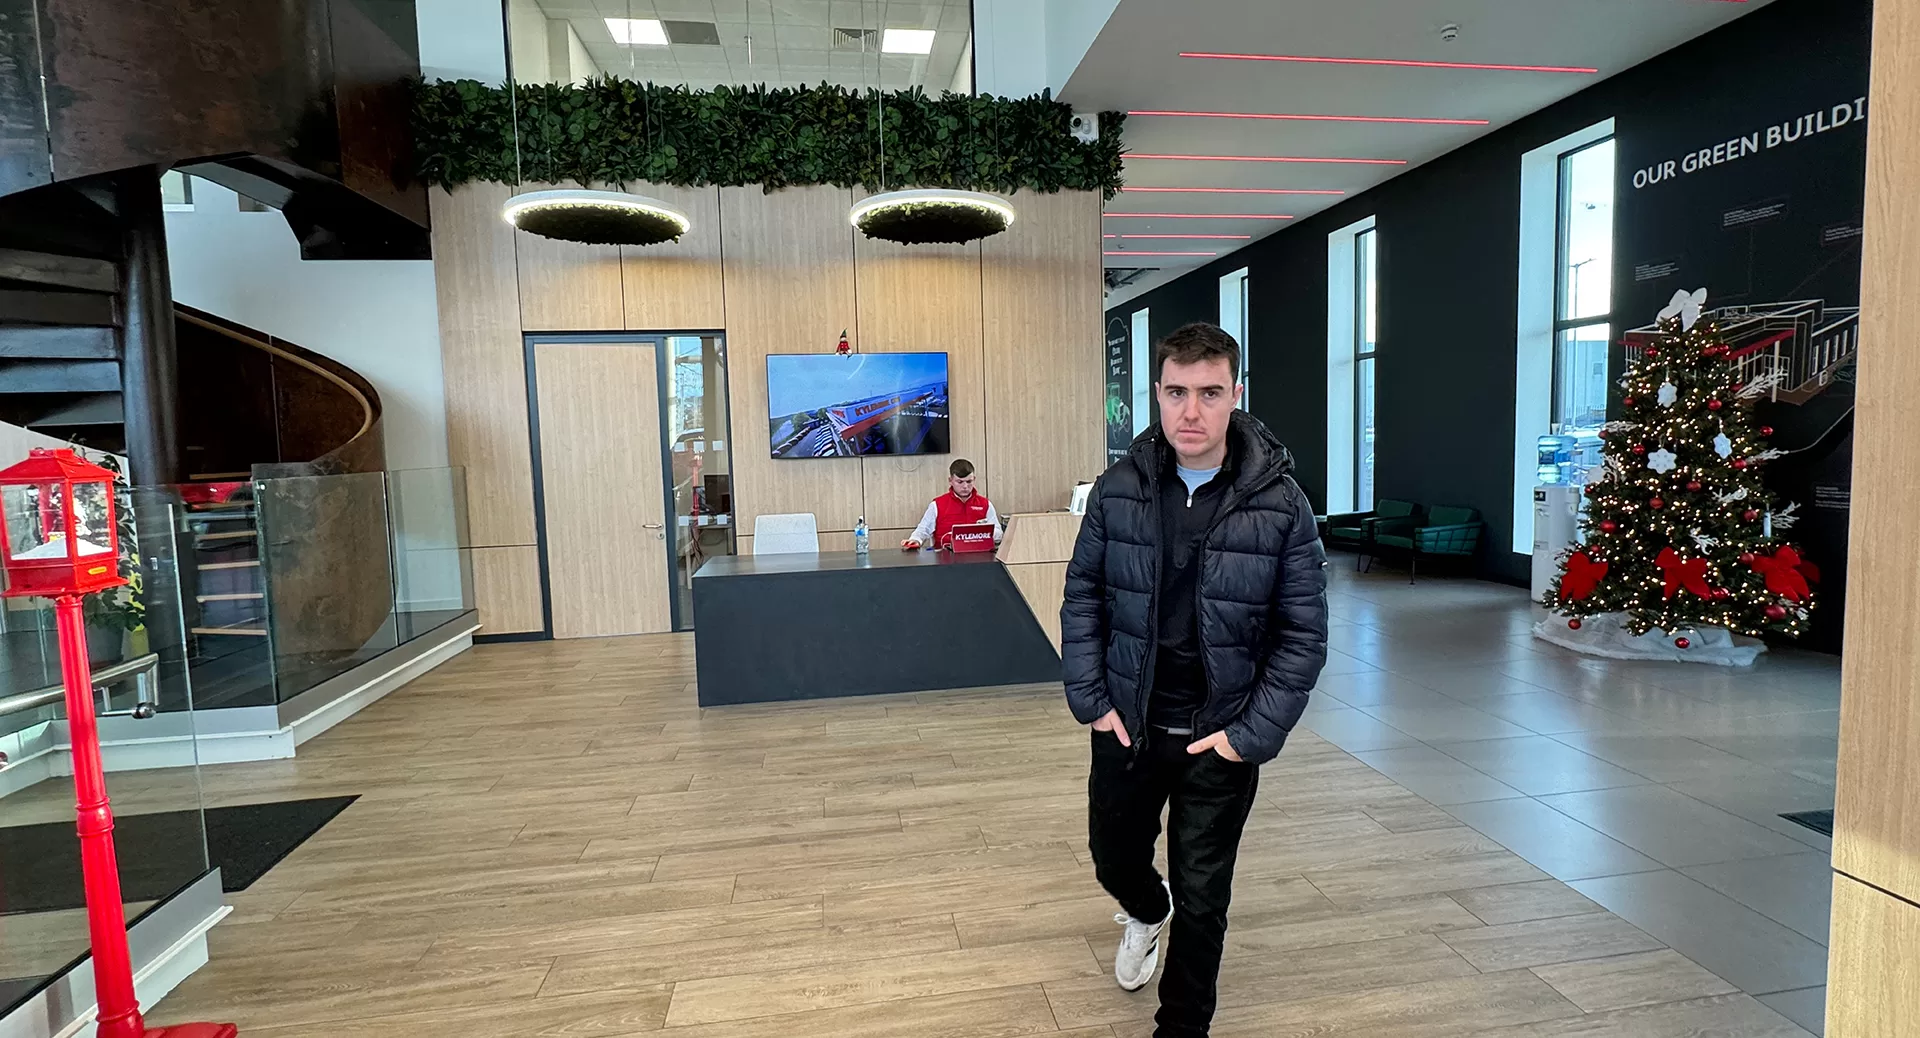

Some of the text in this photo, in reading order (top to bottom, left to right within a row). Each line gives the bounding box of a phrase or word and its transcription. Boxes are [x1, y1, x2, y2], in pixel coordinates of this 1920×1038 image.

[1632, 160, 1676, 189] OUR
[1682, 131, 1759, 173] GREEN
[955, 532, 991, 540] KYLEMORE
